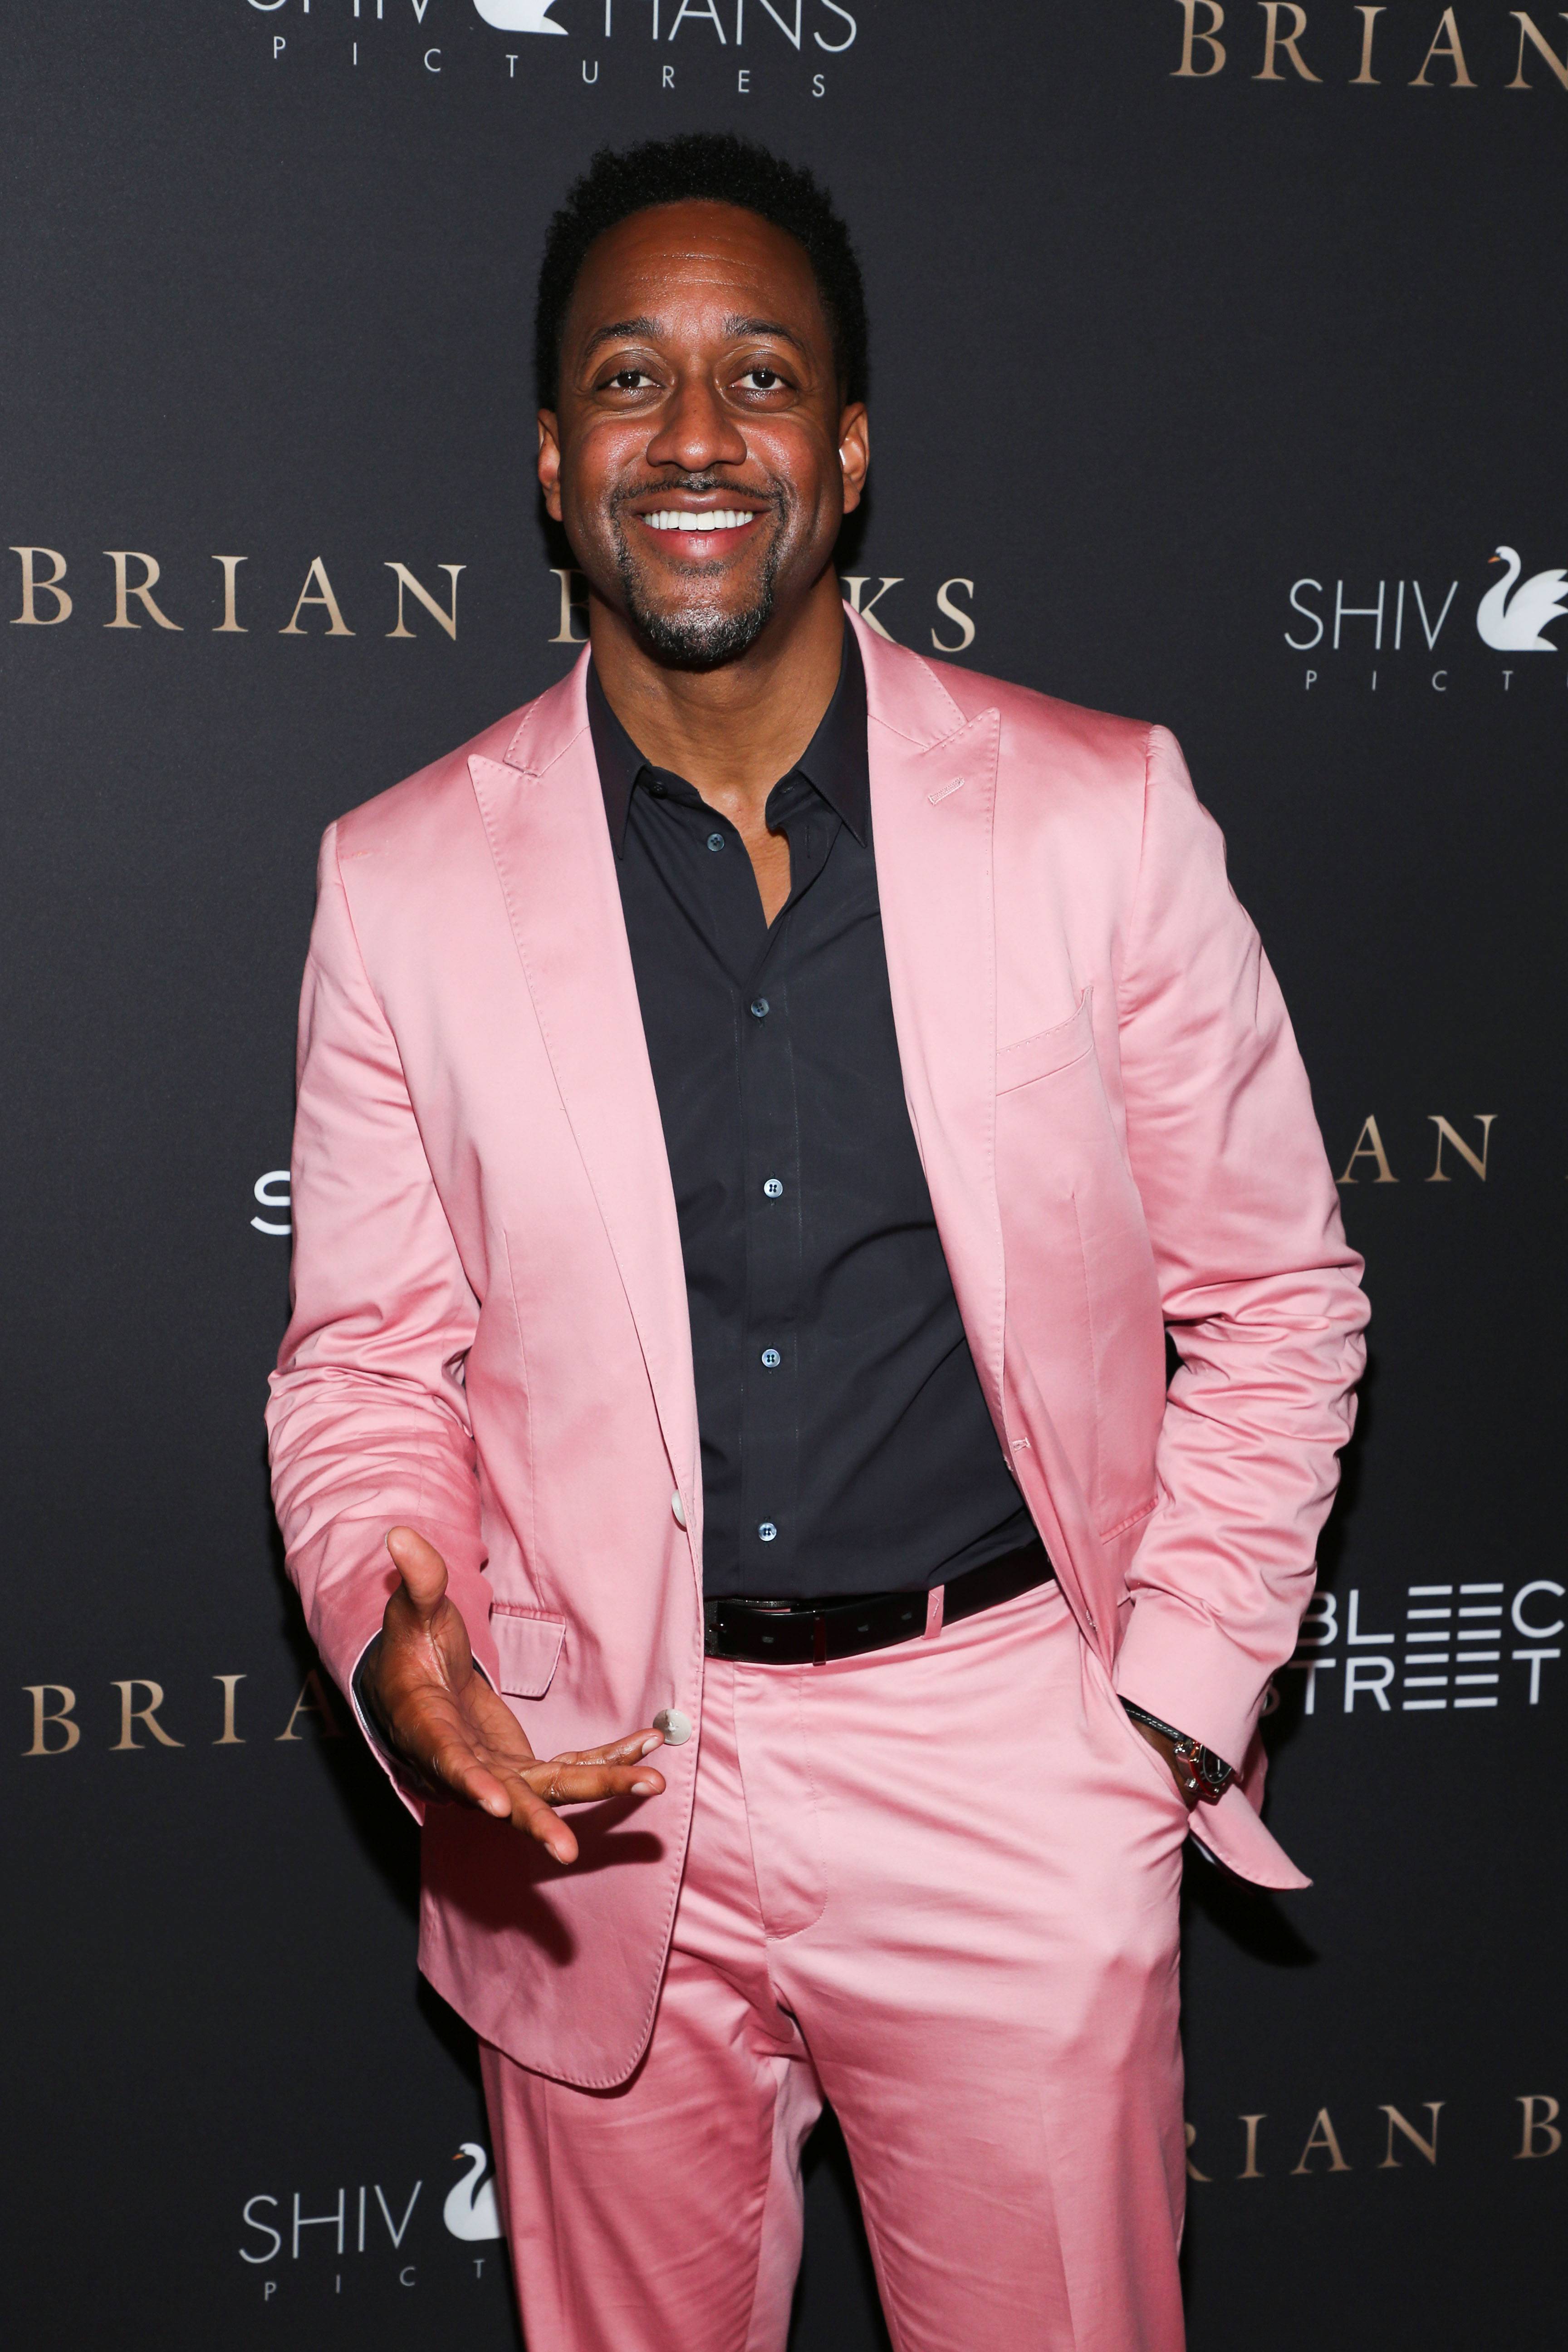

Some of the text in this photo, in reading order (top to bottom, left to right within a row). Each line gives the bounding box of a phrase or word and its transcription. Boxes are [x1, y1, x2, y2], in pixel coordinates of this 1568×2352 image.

[274, 36, 825, 97] PICTURES
[1169, 0, 1568, 91] BRIAN
[9, 546, 975, 652] BRIAN BKS
[1284, 578, 1458, 651] SHIV
[1305, 670, 1568, 692] PICT
[20, 1669, 348, 1756] BRIA
[239, 2180, 422, 2263] SHIV
